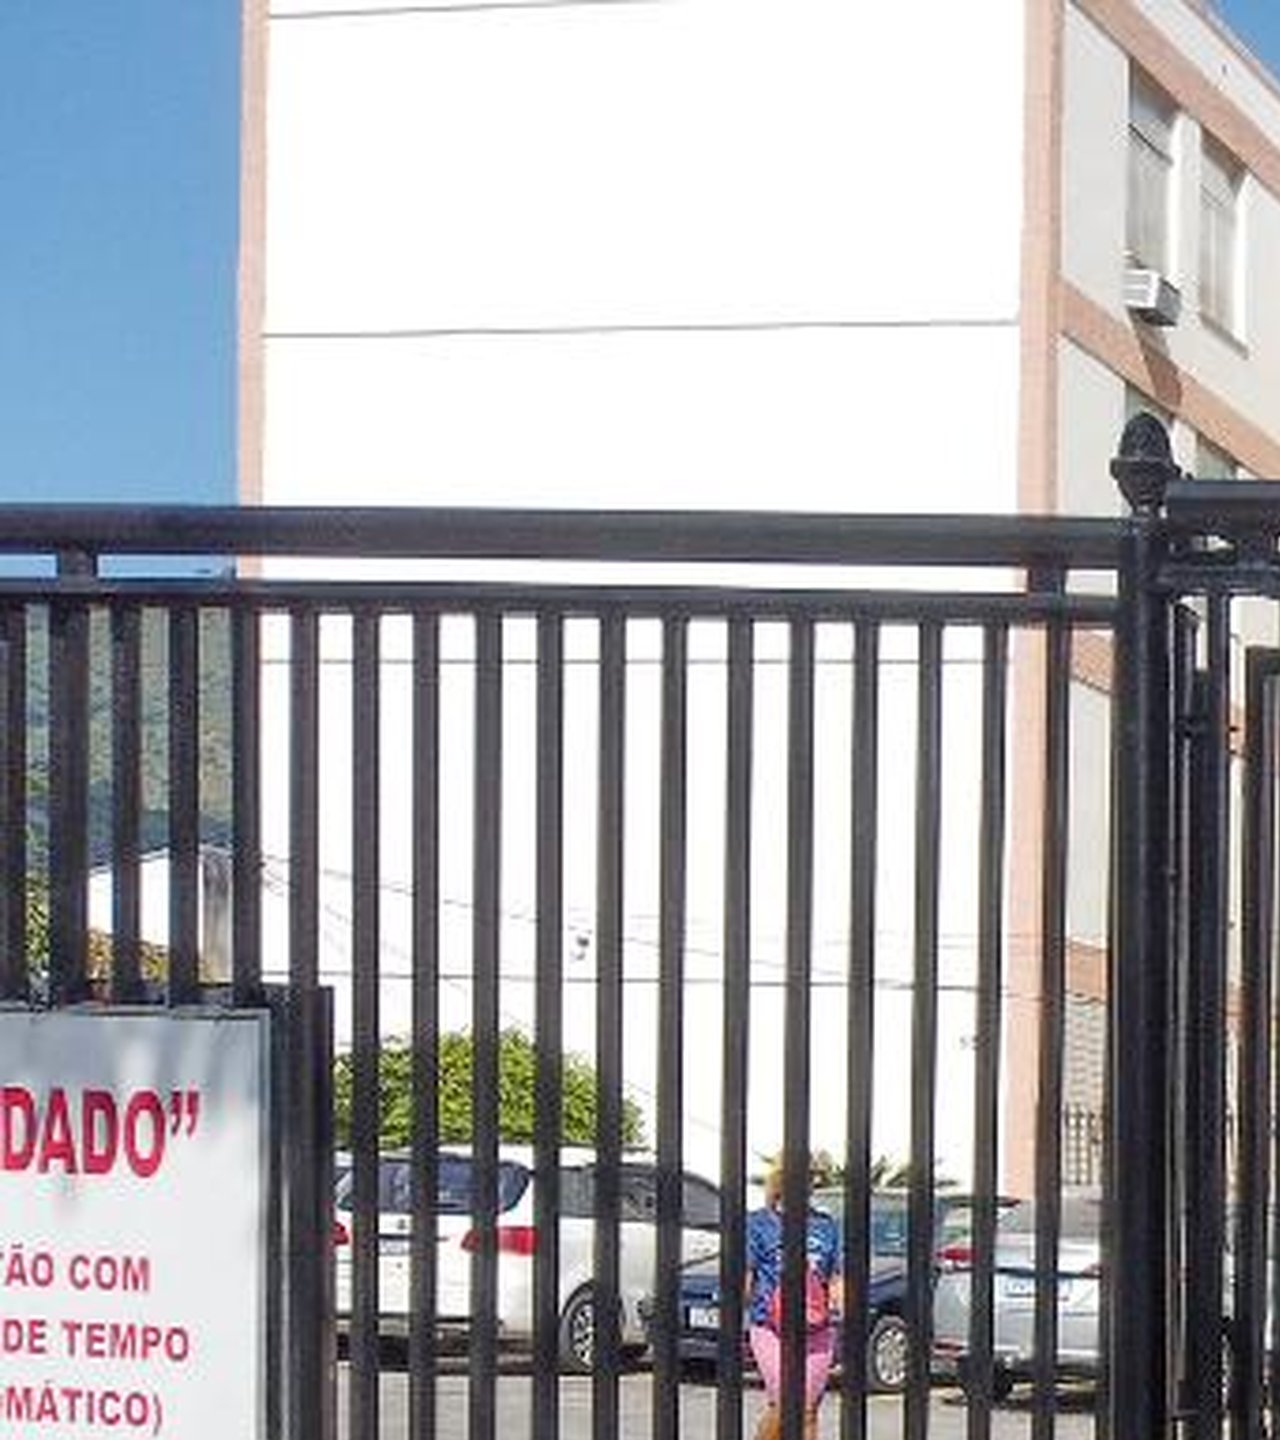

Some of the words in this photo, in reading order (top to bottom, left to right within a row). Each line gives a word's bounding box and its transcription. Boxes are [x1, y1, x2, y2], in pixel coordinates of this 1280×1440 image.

[0, 1243, 54, 1287] ÃO
[69, 1254, 150, 1292] COM
[3, 1319, 46, 1354] DE
[61, 1320, 189, 1361] TEMPO
[0, 1379, 162, 1437] MÁTICO)
